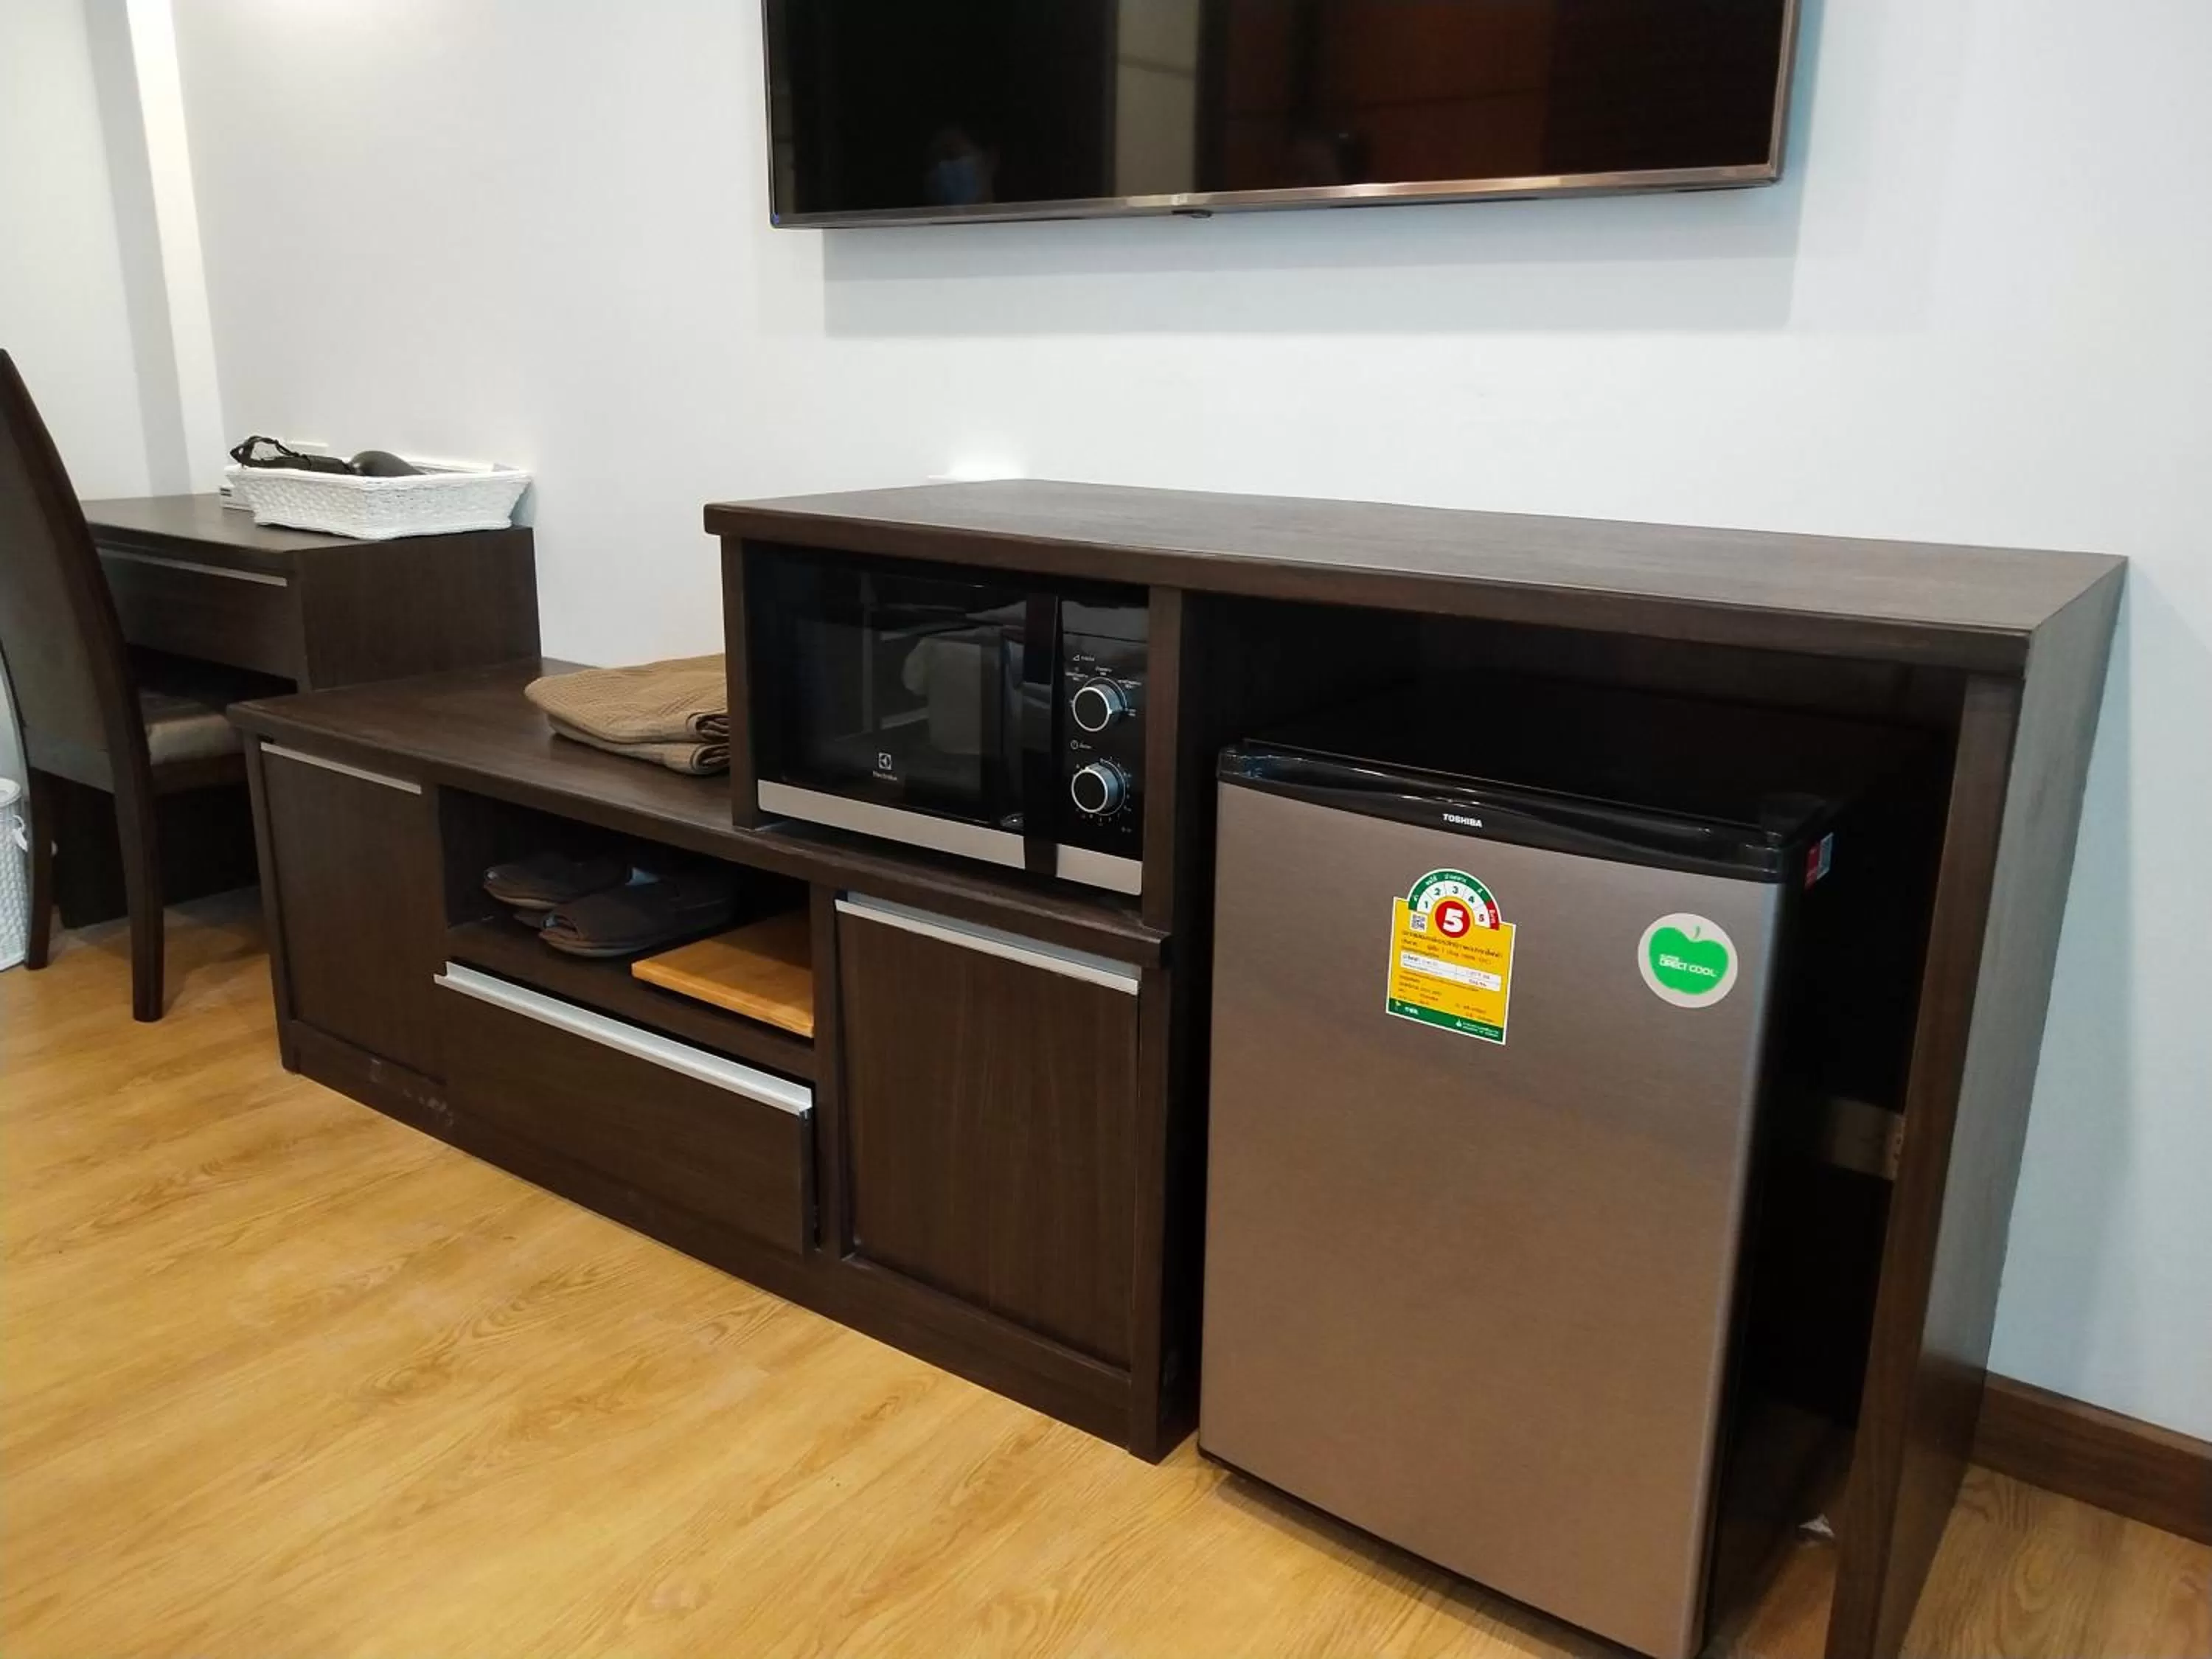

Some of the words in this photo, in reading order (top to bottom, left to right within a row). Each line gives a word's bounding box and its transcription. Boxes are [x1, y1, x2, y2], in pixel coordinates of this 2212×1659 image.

[1442, 813, 1483, 828] TOSHIBA
[1424, 901, 1429, 909] 1
[1434, 887, 1441, 896] 2
[1452, 886, 1459, 894] 3
[1478, 914, 1485, 922] 5
[1442, 908, 1464, 933] 5
[1688, 964, 1717, 977] COOL
